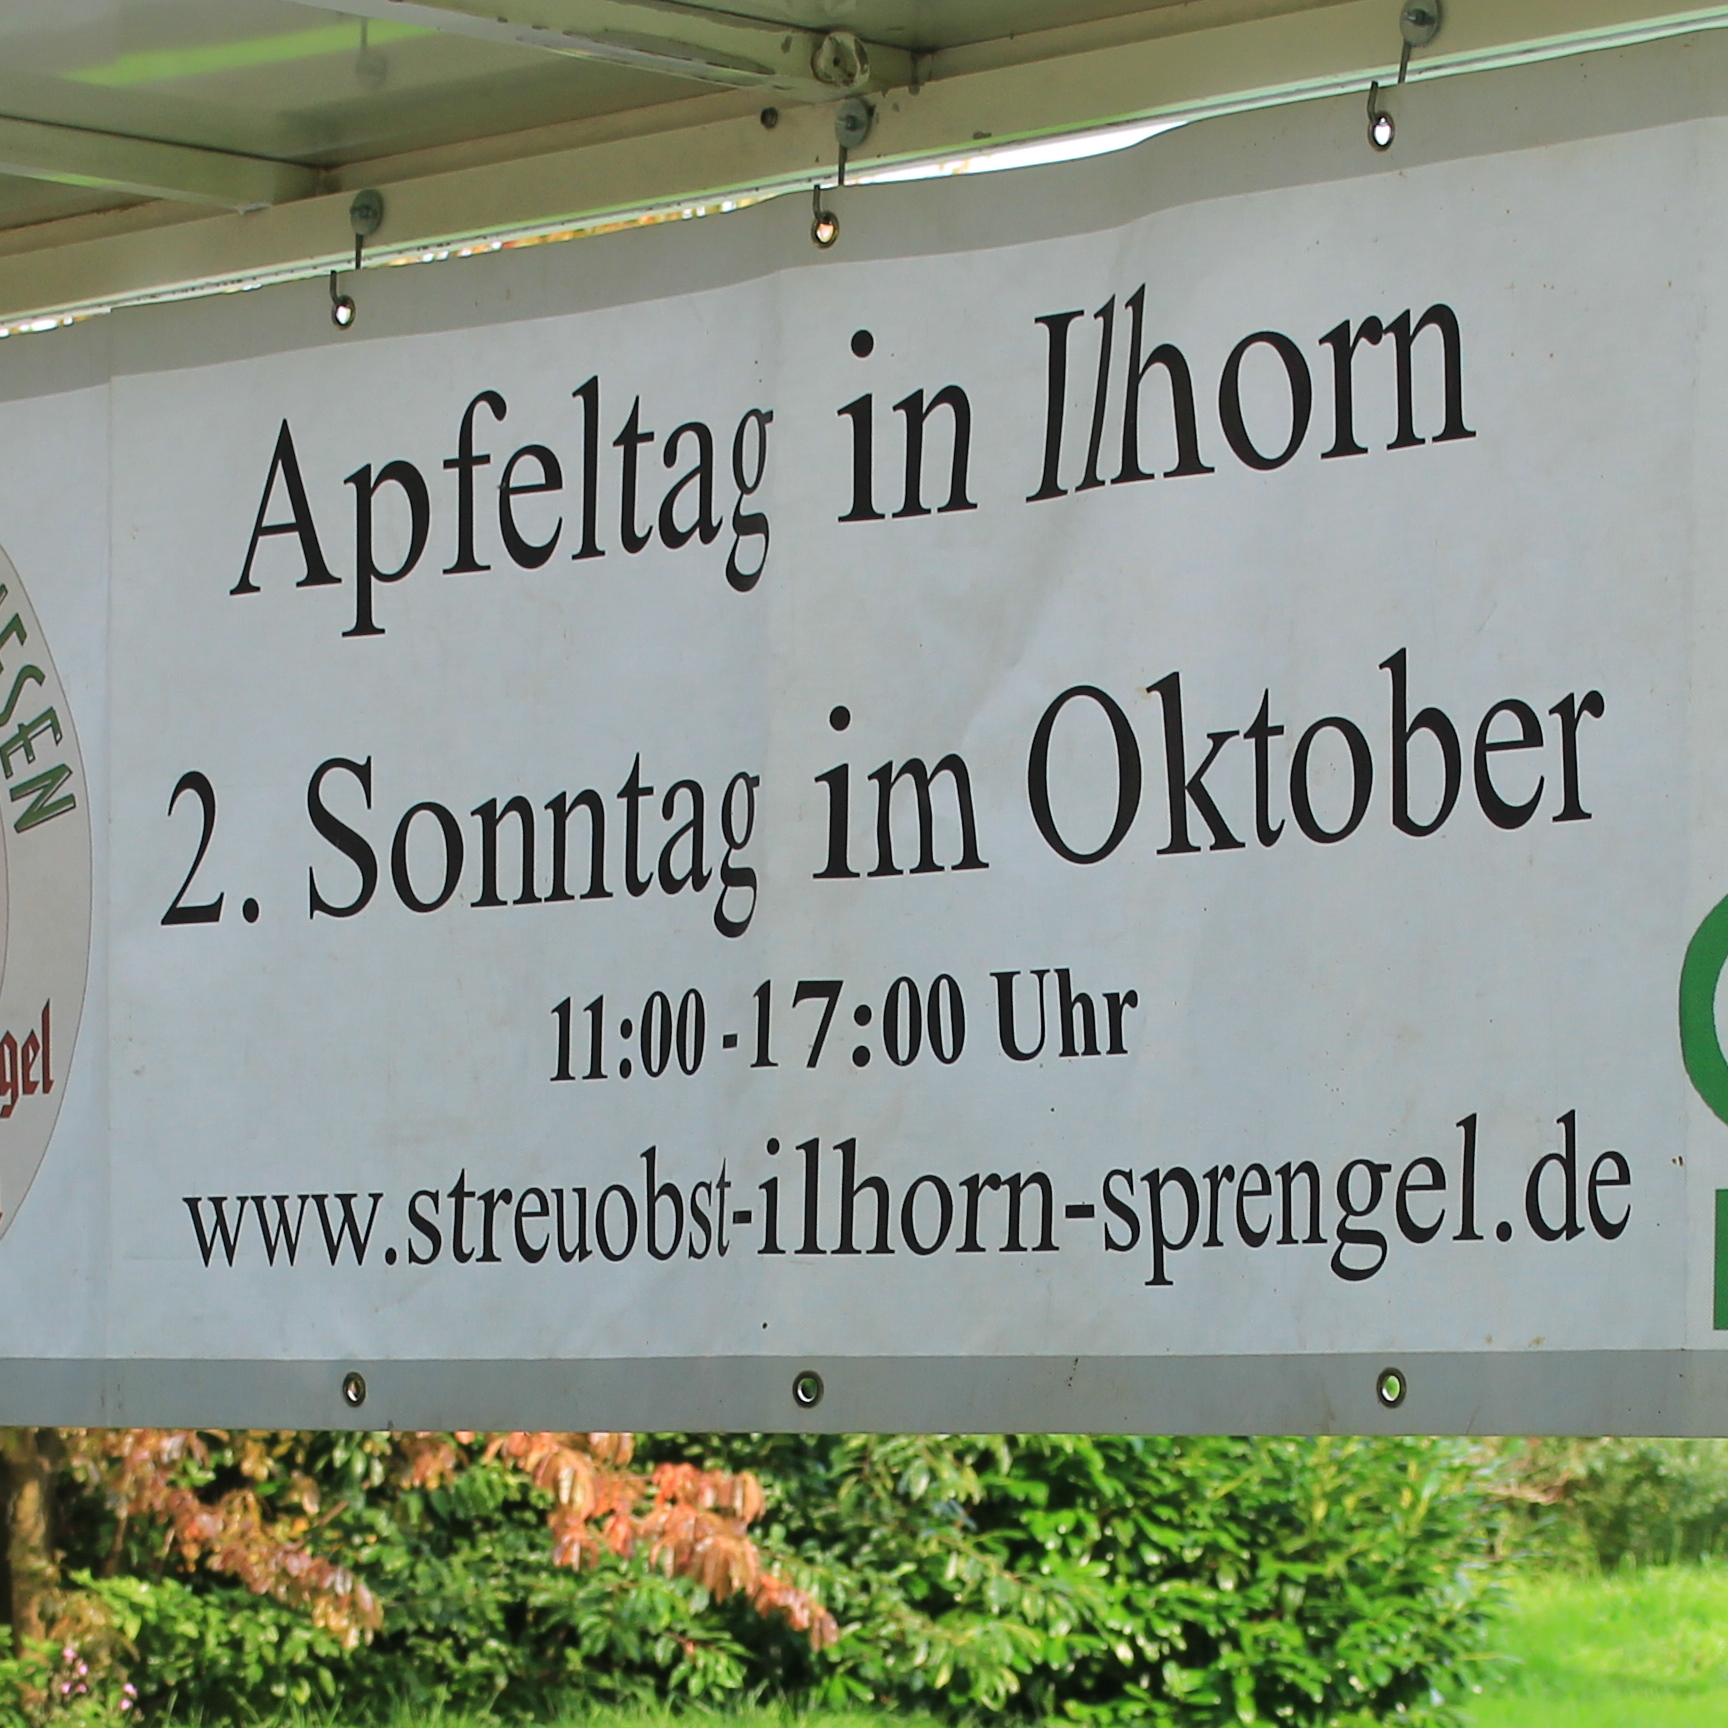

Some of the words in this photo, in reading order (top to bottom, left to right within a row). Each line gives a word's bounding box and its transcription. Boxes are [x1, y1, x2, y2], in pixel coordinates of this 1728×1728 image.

[228, 375, 775, 639] Apfeltag
[835, 328, 979, 524] in
[1024, 283, 1478, 504] Ilhorn
[159, 769, 262, 927] 2.
[307, 751, 761, 940] Sonntag
[812, 705, 991, 880] im
[1024, 646, 1606, 866] Oktober
[990, 967, 1139, 1062] Uhr
[182, 1109, 1632, 1287] www.streuobst-ilhorn-sprengel.de
